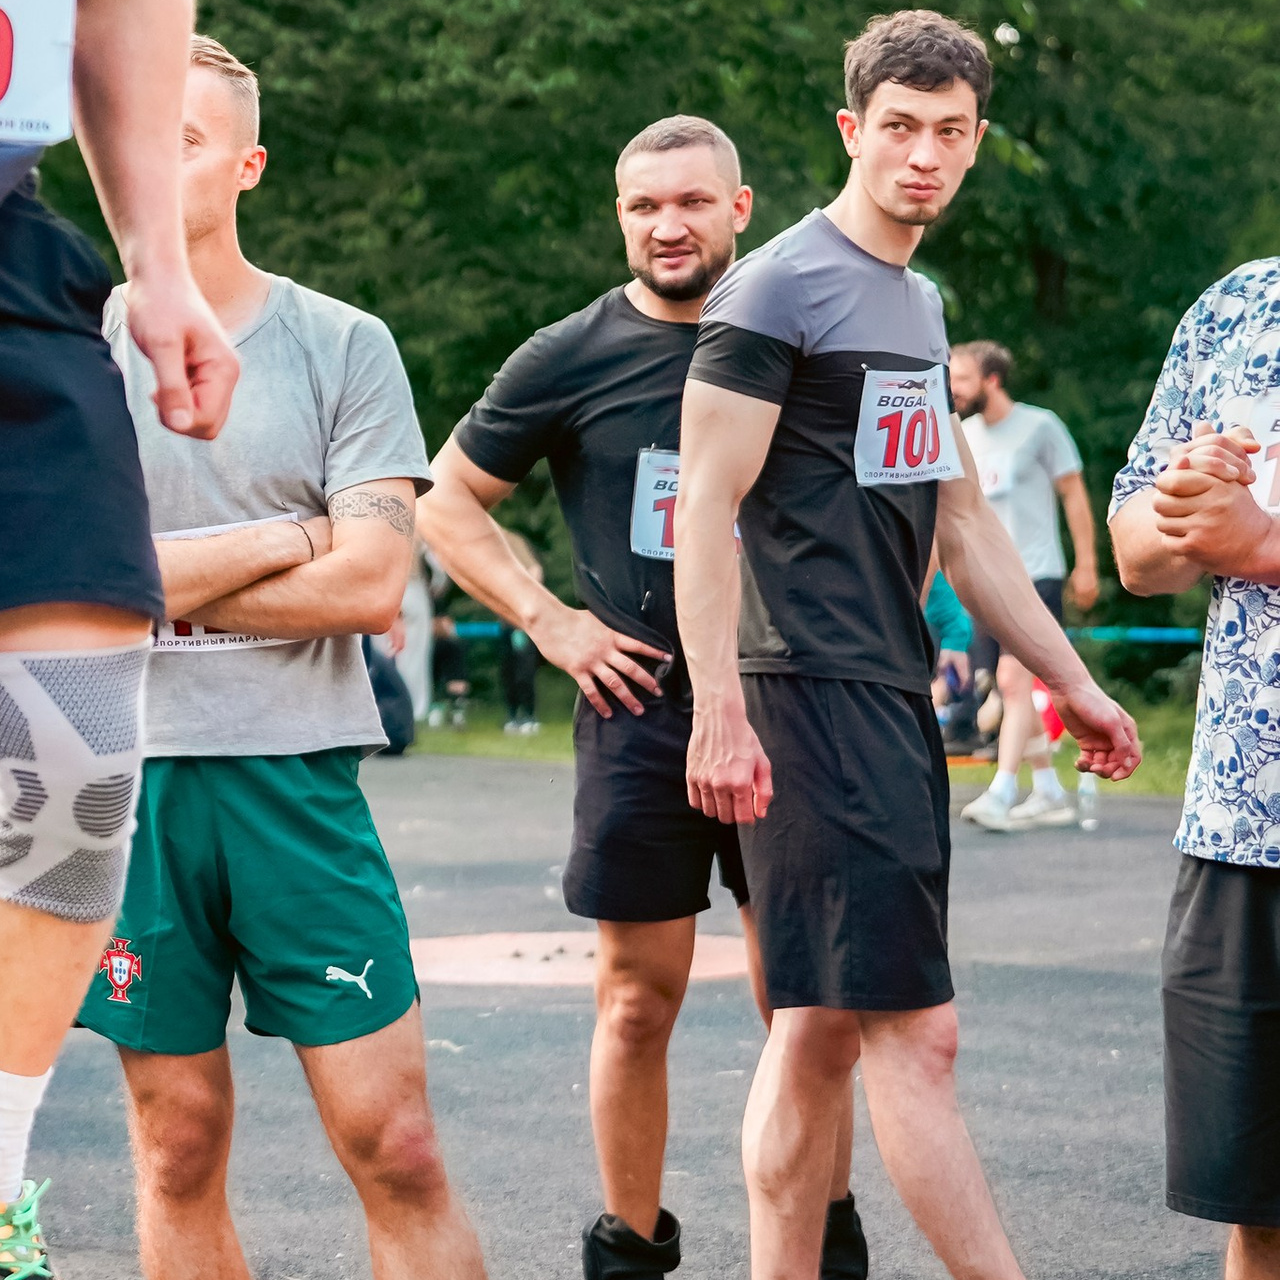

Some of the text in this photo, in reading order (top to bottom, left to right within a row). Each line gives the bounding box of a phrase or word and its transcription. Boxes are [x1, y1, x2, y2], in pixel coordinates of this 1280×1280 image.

[877, 395, 927, 408] BOGAL
[876, 405, 940, 468] 100
[641, 548, 675, 557] СПОРТИ
[228, 635, 273, 644] МАРА
